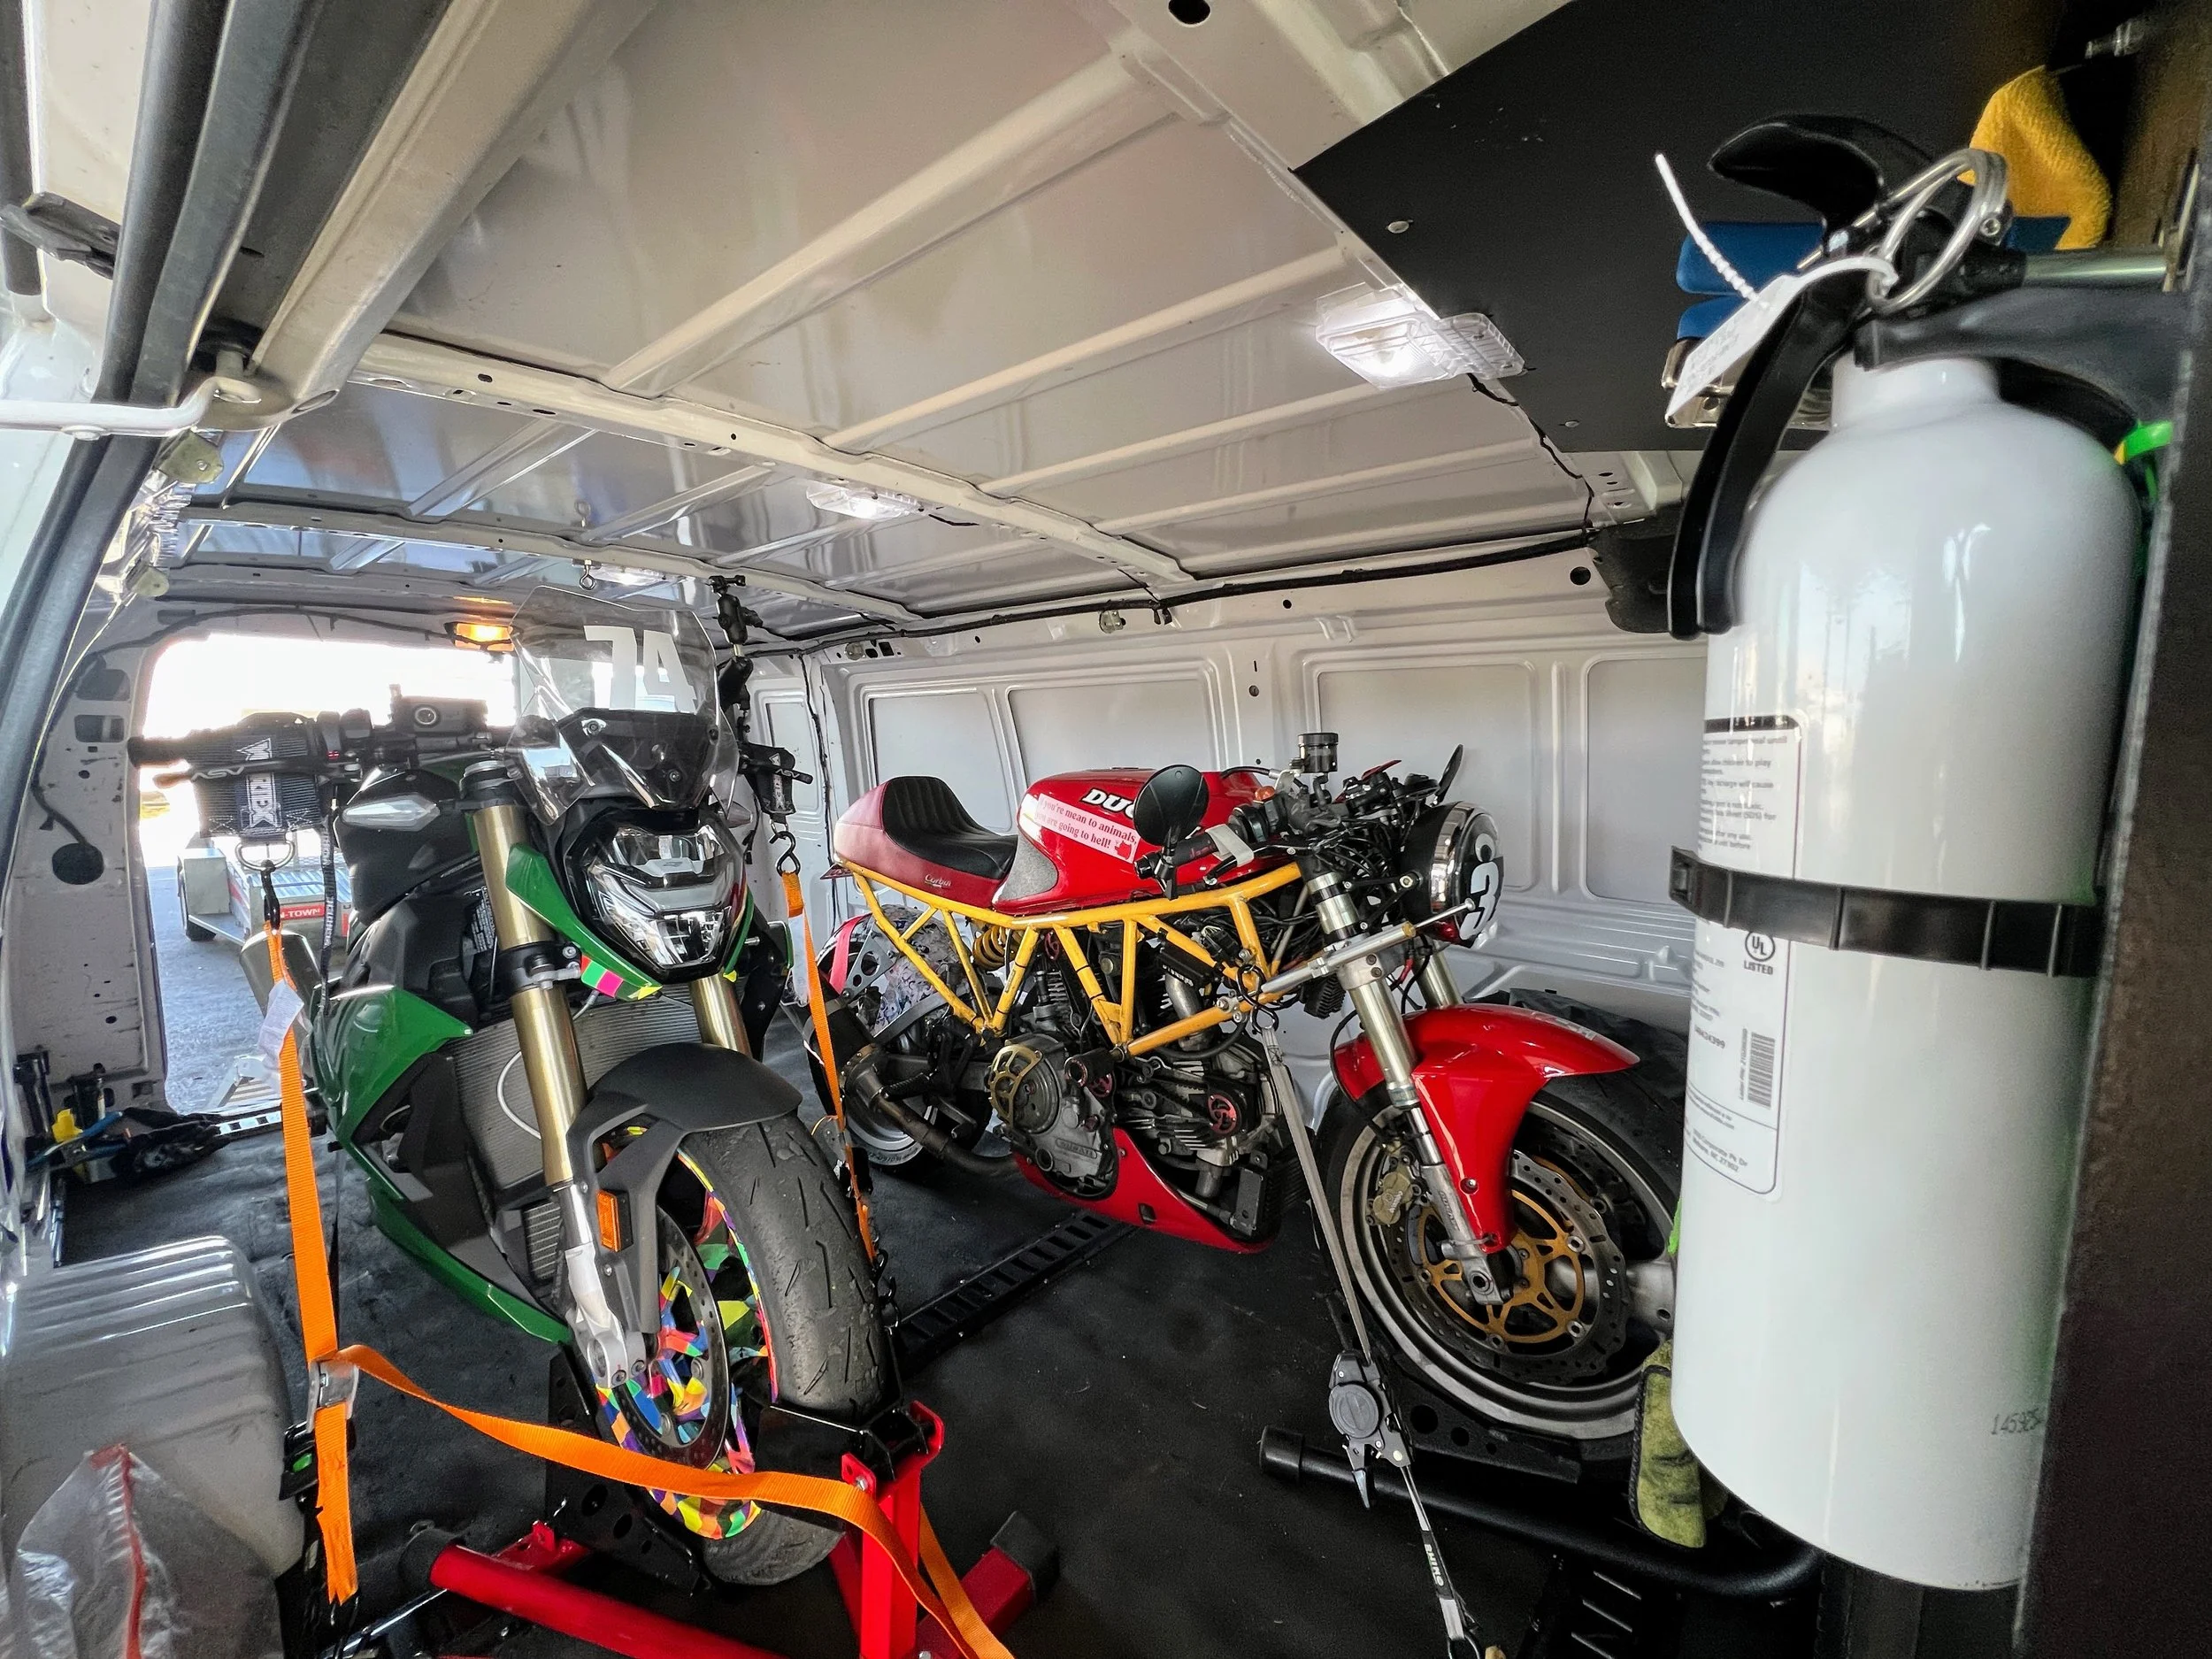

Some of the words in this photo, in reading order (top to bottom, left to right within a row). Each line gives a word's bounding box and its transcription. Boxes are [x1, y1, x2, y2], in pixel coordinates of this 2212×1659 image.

[583, 617, 697, 715] 74
[191, 765, 245, 782] ASV
[775, 768, 800, 779] ASV
[1041, 800, 1064, 816] you're
[1064, 810, 1087, 824] mean
[1088, 817, 1097, 827] to
[1098, 823, 1138, 845] animals,
[1046, 817, 1058, 826] are
[1059, 822, 1079, 838] going
[1080, 829, 1089, 840] to
[1091, 832, 1112, 849] hell!
[1459, 862, 1499, 940] 3
[1752, 935, 1767, 956] UL
[1743, 960, 1774, 975] LISTED
[1425, 1543, 1444, 1586] RHINO
